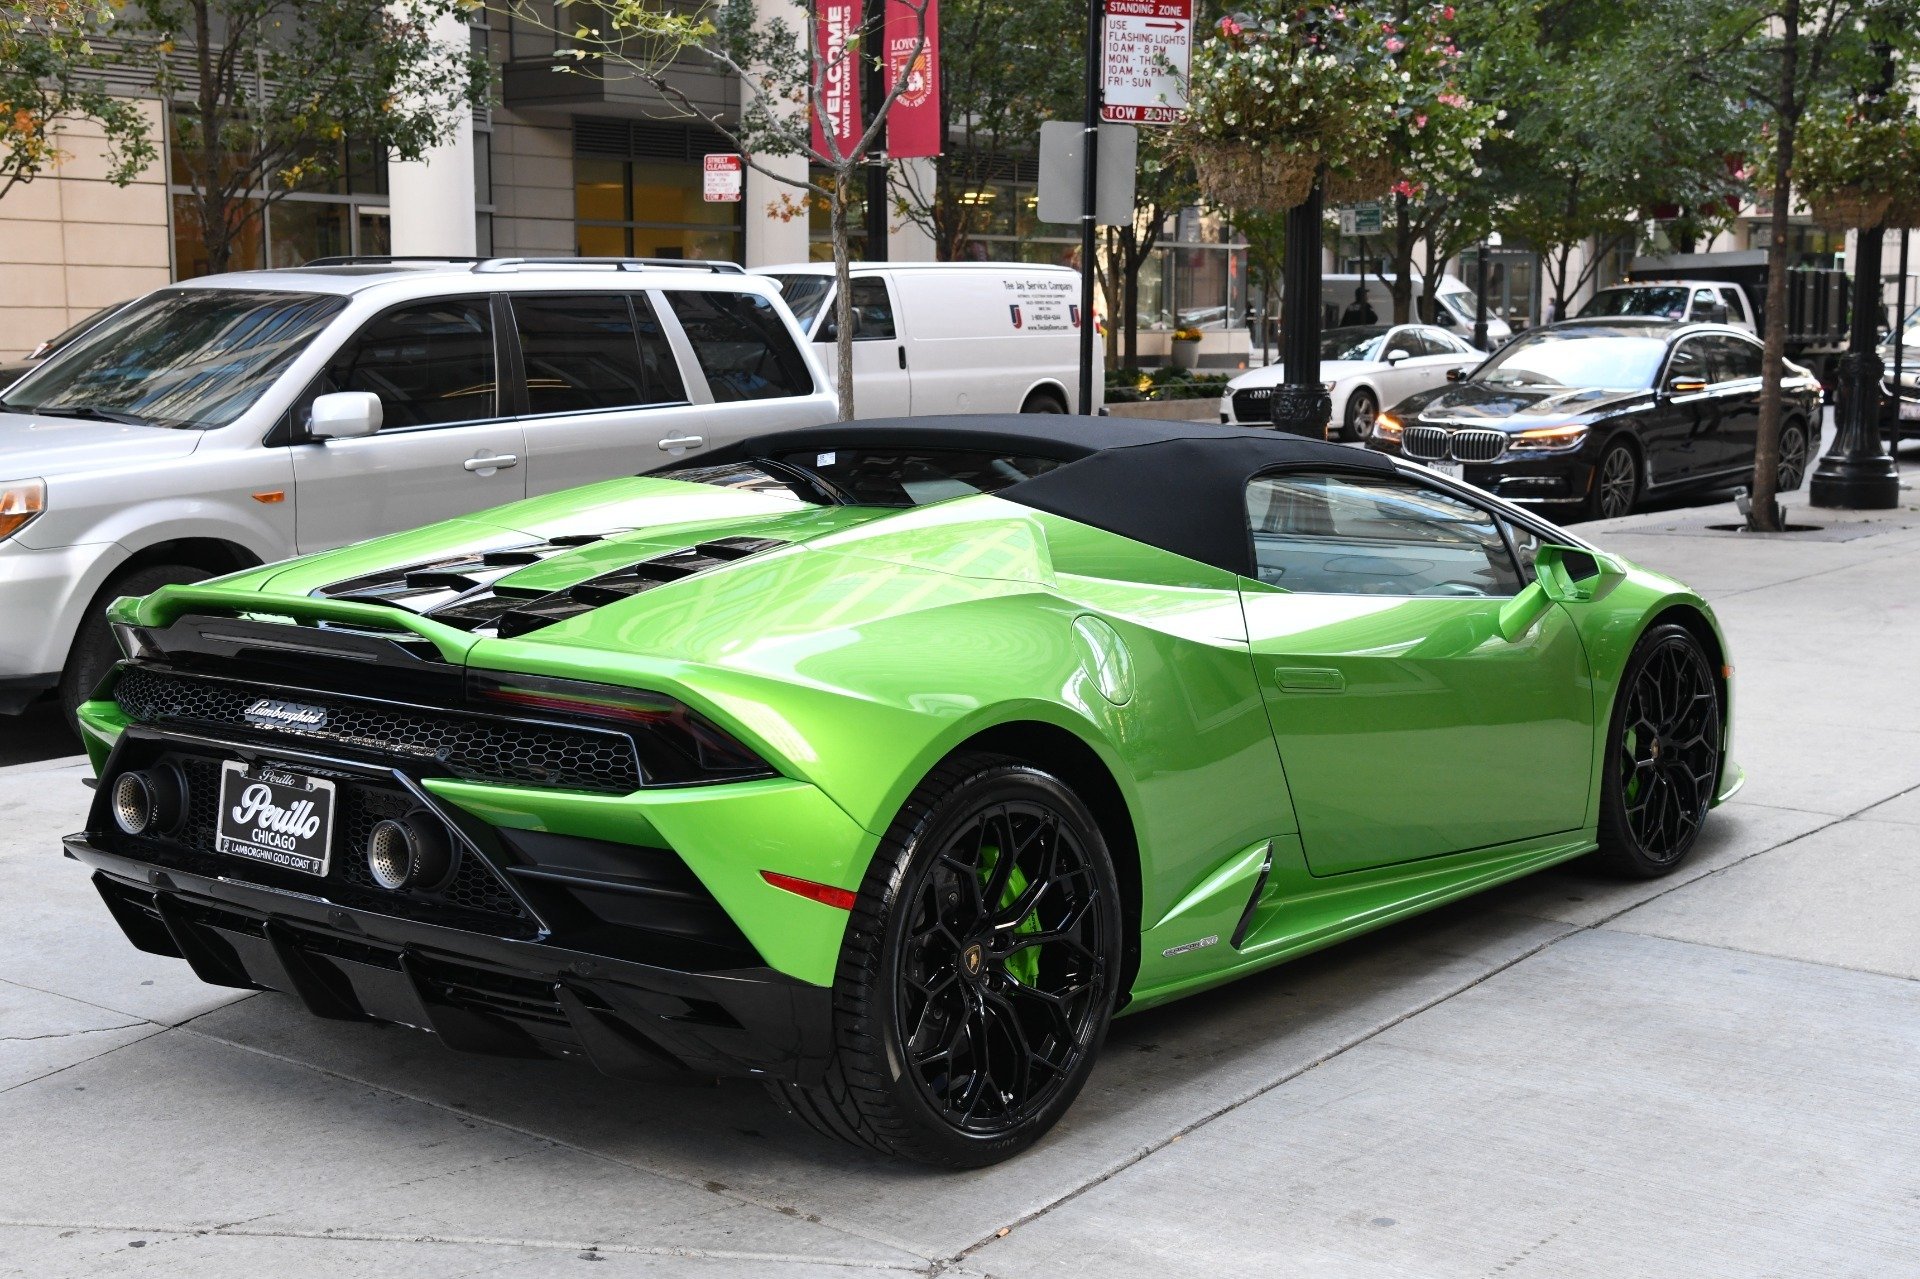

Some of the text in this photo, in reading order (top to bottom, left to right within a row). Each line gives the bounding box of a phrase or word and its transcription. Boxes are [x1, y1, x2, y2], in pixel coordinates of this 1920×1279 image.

[1110, 2, 1182, 16] STANDING ZONE
[1109, 20, 1127, 30] USE
[891, 36, 931, 50] LOYOA
[1109, 31, 1186, 45] FLASHING LIGHTS
[1109, 42, 1118, 52] 10
[1120, 44, 1134, 53] AM
[1144, 45, 1149, 54] 8
[1153, 46, 1166, 54] PM
[1108, 54, 1129, 63] MON
[827, 6, 842, 136] WELCOME
[843, 6, 851, 139] WATER TOWER CMPUS
[1109, 65, 1118, 74] 10
[1119, 66, 1133, 75] AM
[1143, 67, 1149, 77] 6
[1108, 77, 1123, 86] FRI
[1132, 78, 1152, 87] SUN
[1107, 106, 1137, 119] TOW
[1003, 281, 1014, 290] Tee
[1026, 281, 1047, 290] Service
[1049, 281, 1073, 292] Company
[244, 700, 323, 724] Lamborghini
[258, 769, 296, 786] Perillo
[232, 783, 320, 839] Perillo
[252, 828, 296, 850] CHICAGO
[231, 842, 310, 870] LAMBORGHINI GOLD COAST
